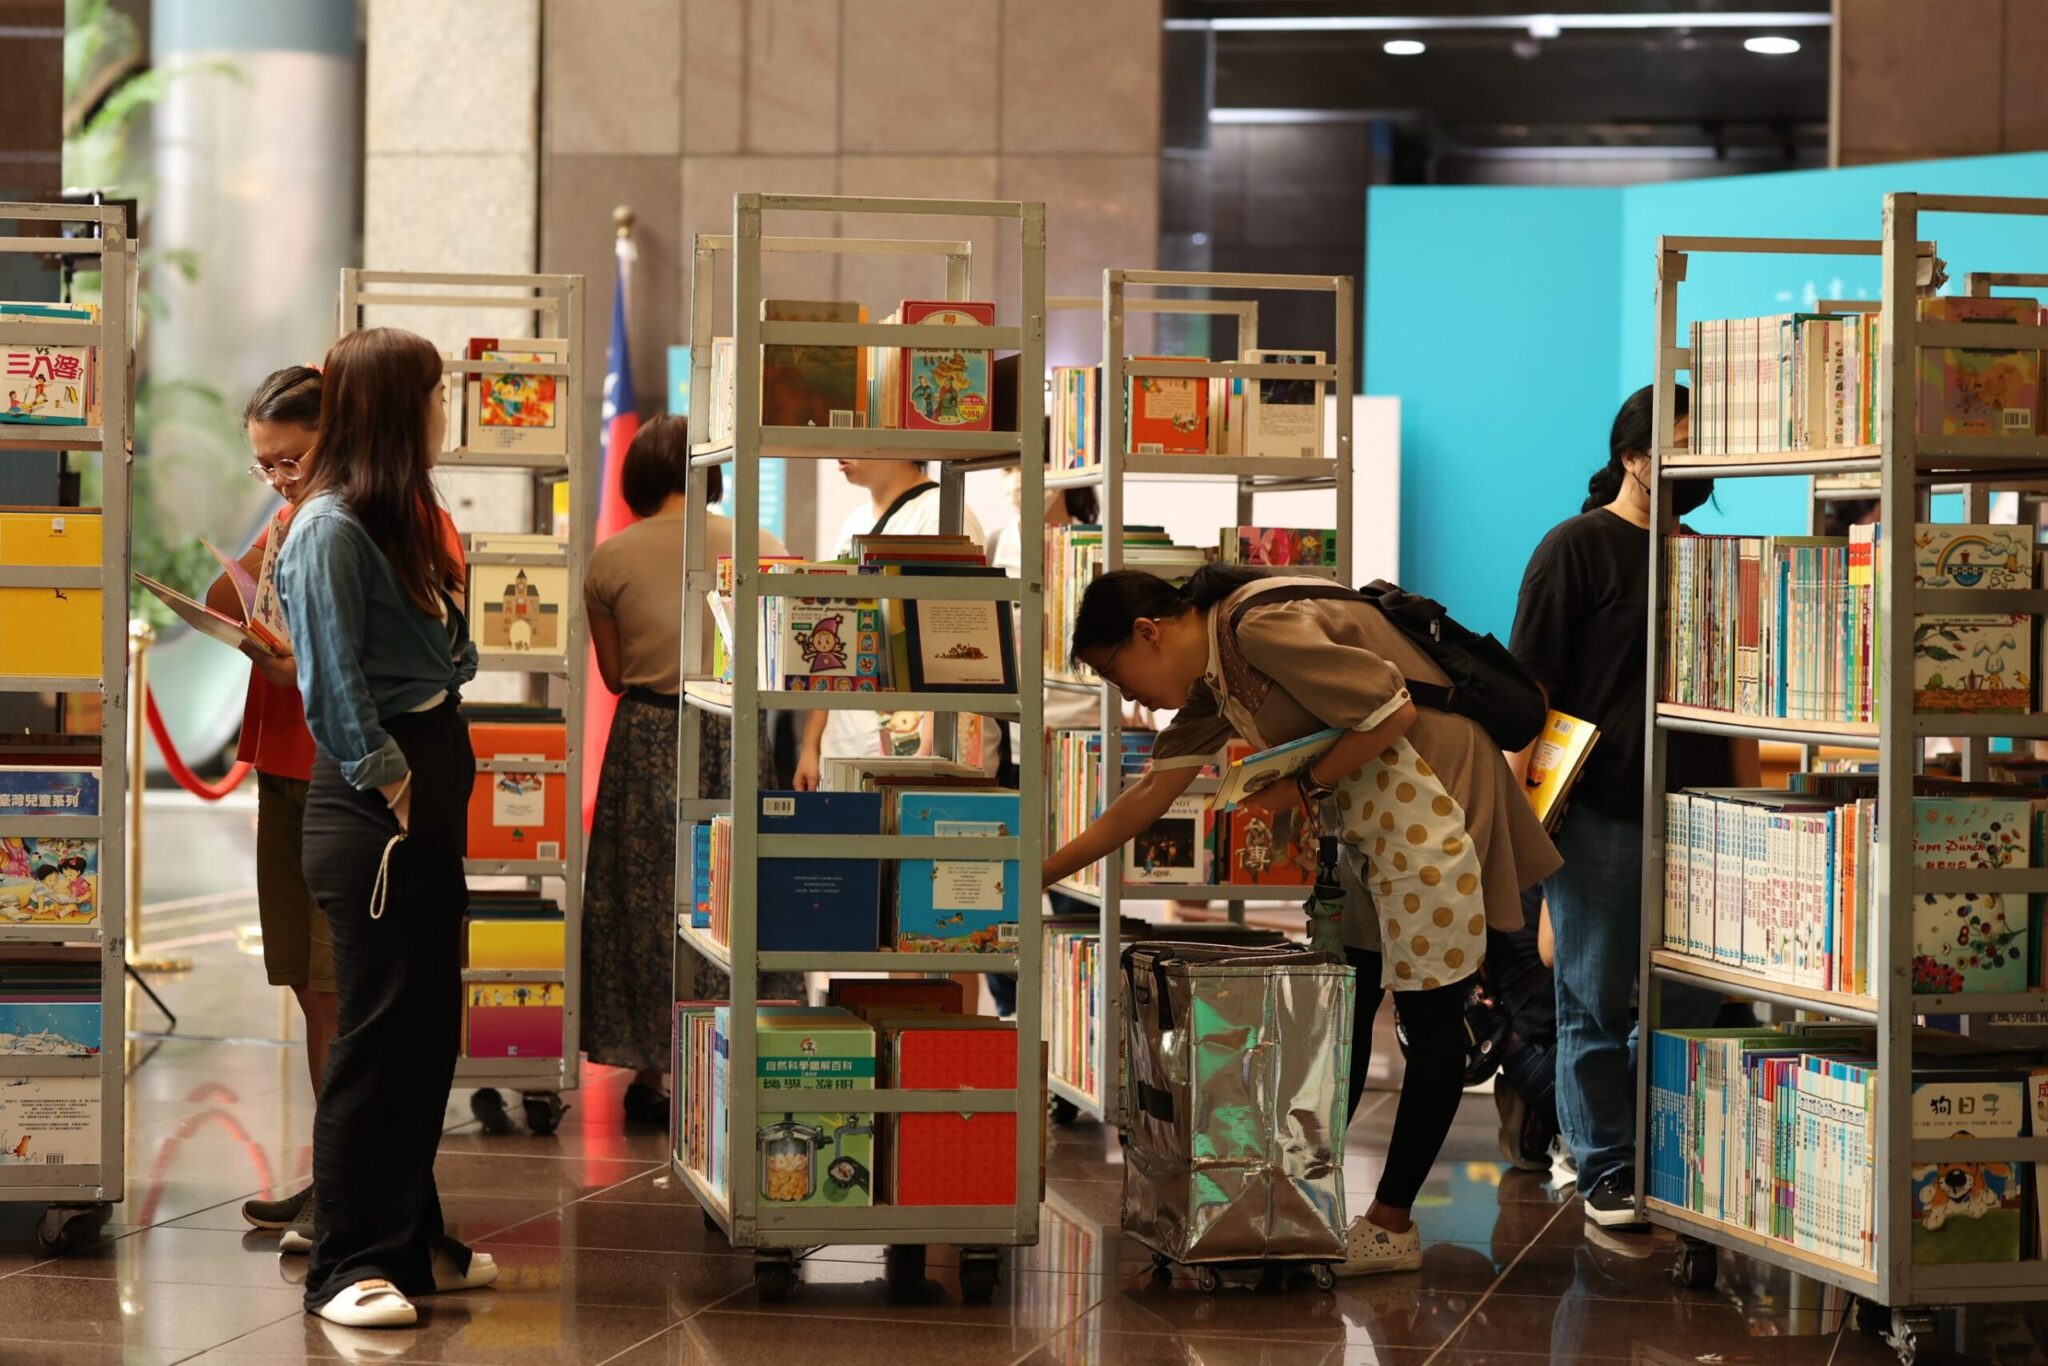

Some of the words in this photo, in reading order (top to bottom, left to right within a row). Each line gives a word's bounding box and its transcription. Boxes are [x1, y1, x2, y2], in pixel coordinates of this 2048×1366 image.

[765, 1060, 853, 1071] 自然科學圖解百科
[1929, 1092, 2000, 1116] 狗日子
